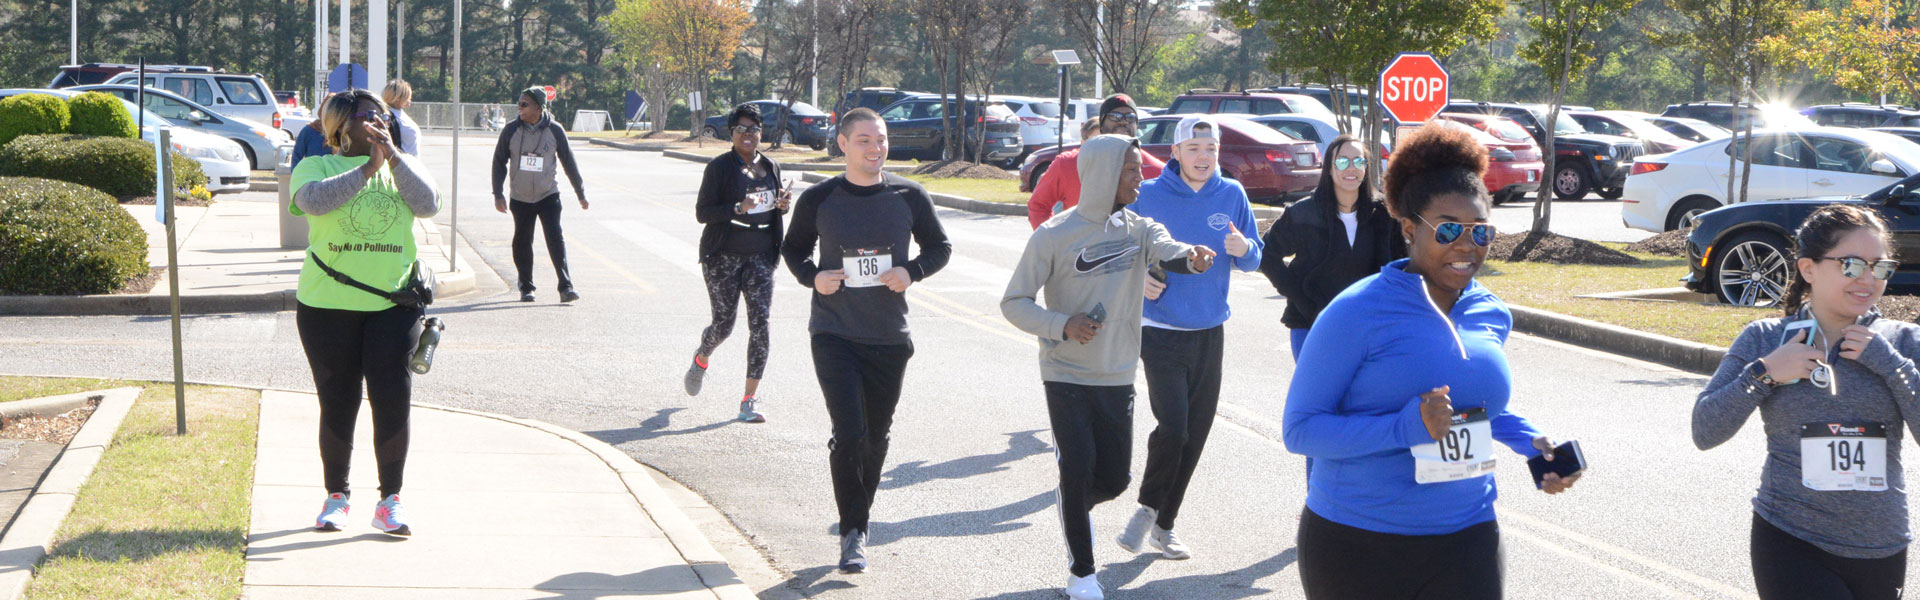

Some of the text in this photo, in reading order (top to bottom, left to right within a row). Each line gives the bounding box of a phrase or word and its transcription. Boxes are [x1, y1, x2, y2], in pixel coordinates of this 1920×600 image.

[1386, 76, 1443, 102] STOP
[526, 157, 537, 166] 122
[328, 242, 342, 253] Say
[363, 243, 403, 254] Pollution
[857, 257, 878, 276] 136
[1439, 428, 1474, 462] 192
[1827, 440, 1866, 471] 194
